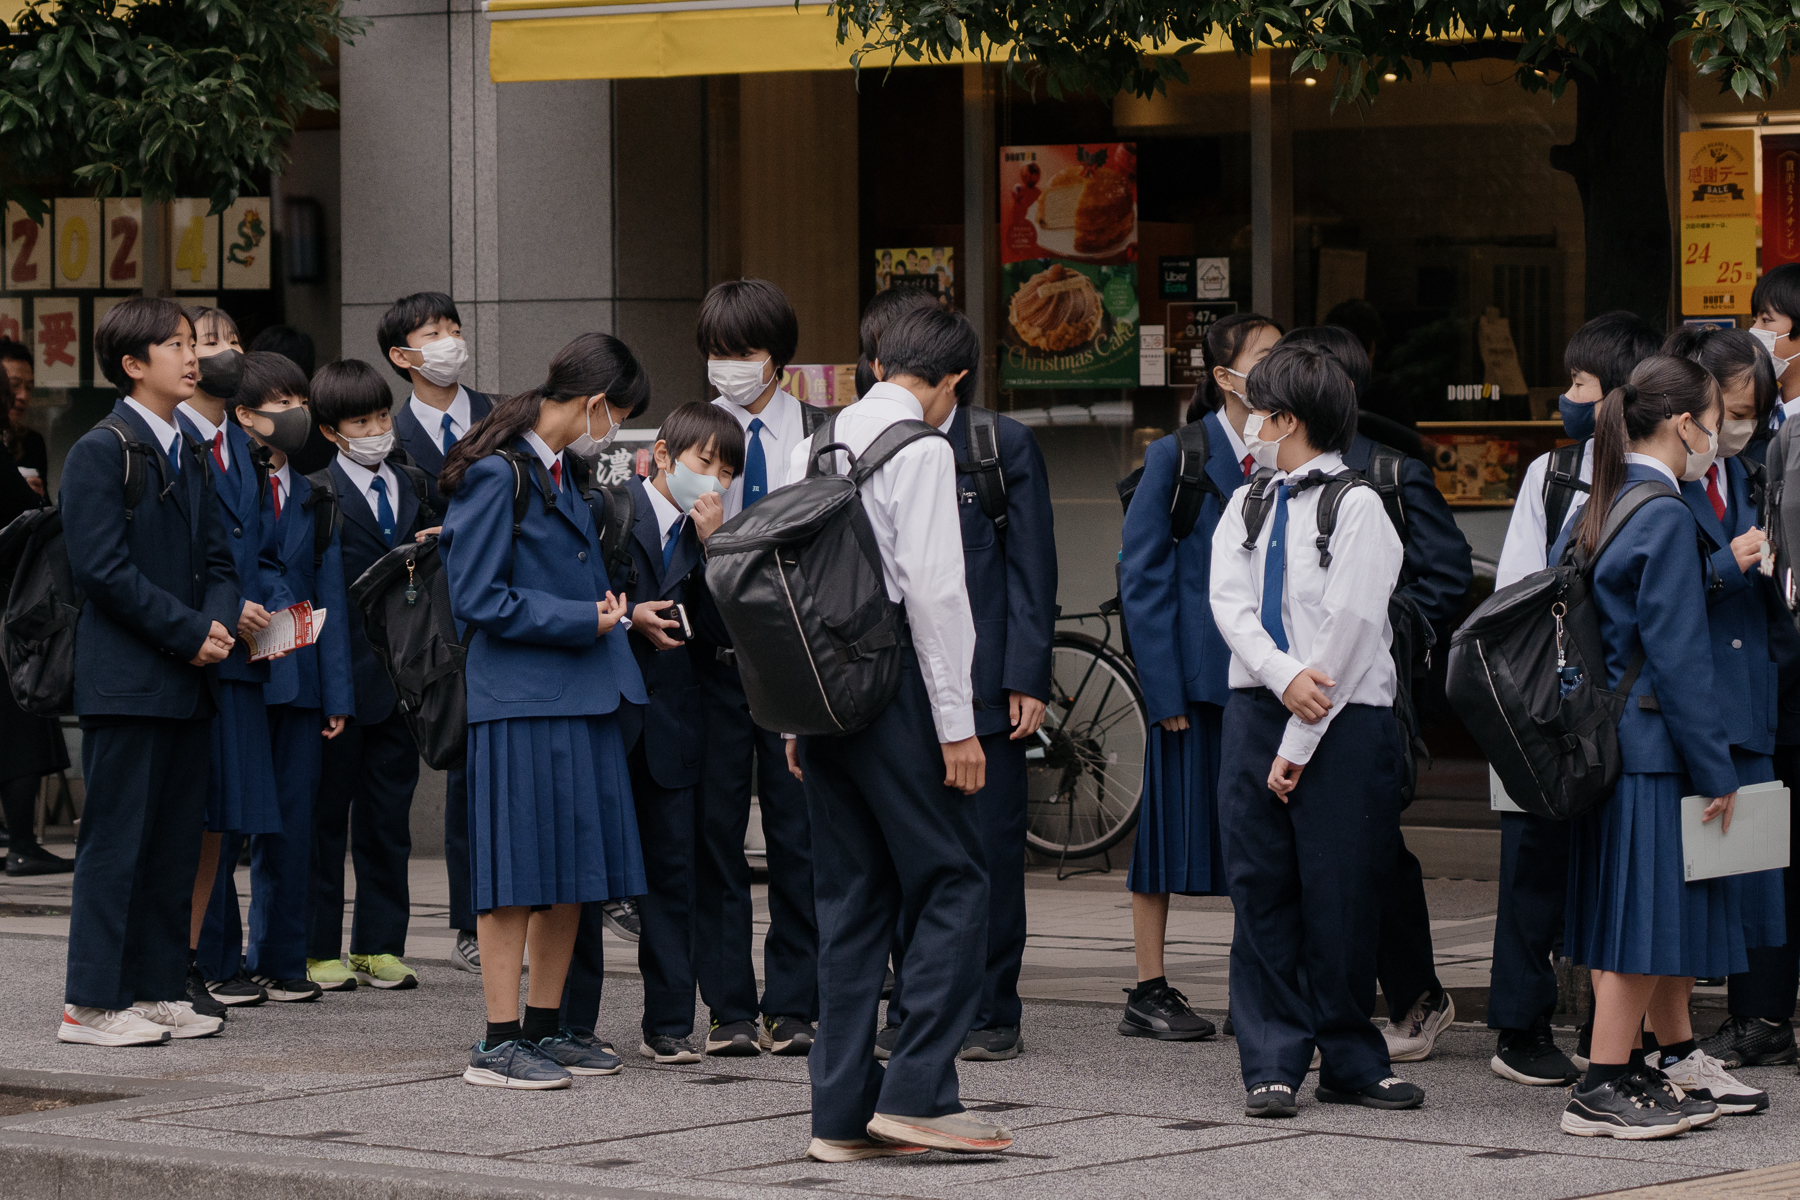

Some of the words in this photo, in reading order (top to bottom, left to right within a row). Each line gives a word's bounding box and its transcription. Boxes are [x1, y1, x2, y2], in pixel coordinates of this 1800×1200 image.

[1688, 165, 1748, 184] 感謝デー
[1707, 185, 1729, 194] SALE
[11, 215, 207, 283] 2024
[1685, 241, 1711, 265] 24
[1164, 270, 1188, 281] Uber
[1164, 282, 1188, 293] Eats
[1703, 294, 1734, 304] DOUTOR
[1008, 345, 1094, 371] Christmas
[1094, 322, 1136, 356] Cake
[1447, 383, 1500, 401] DOUTOR
[596, 447, 633, 486] 濃
